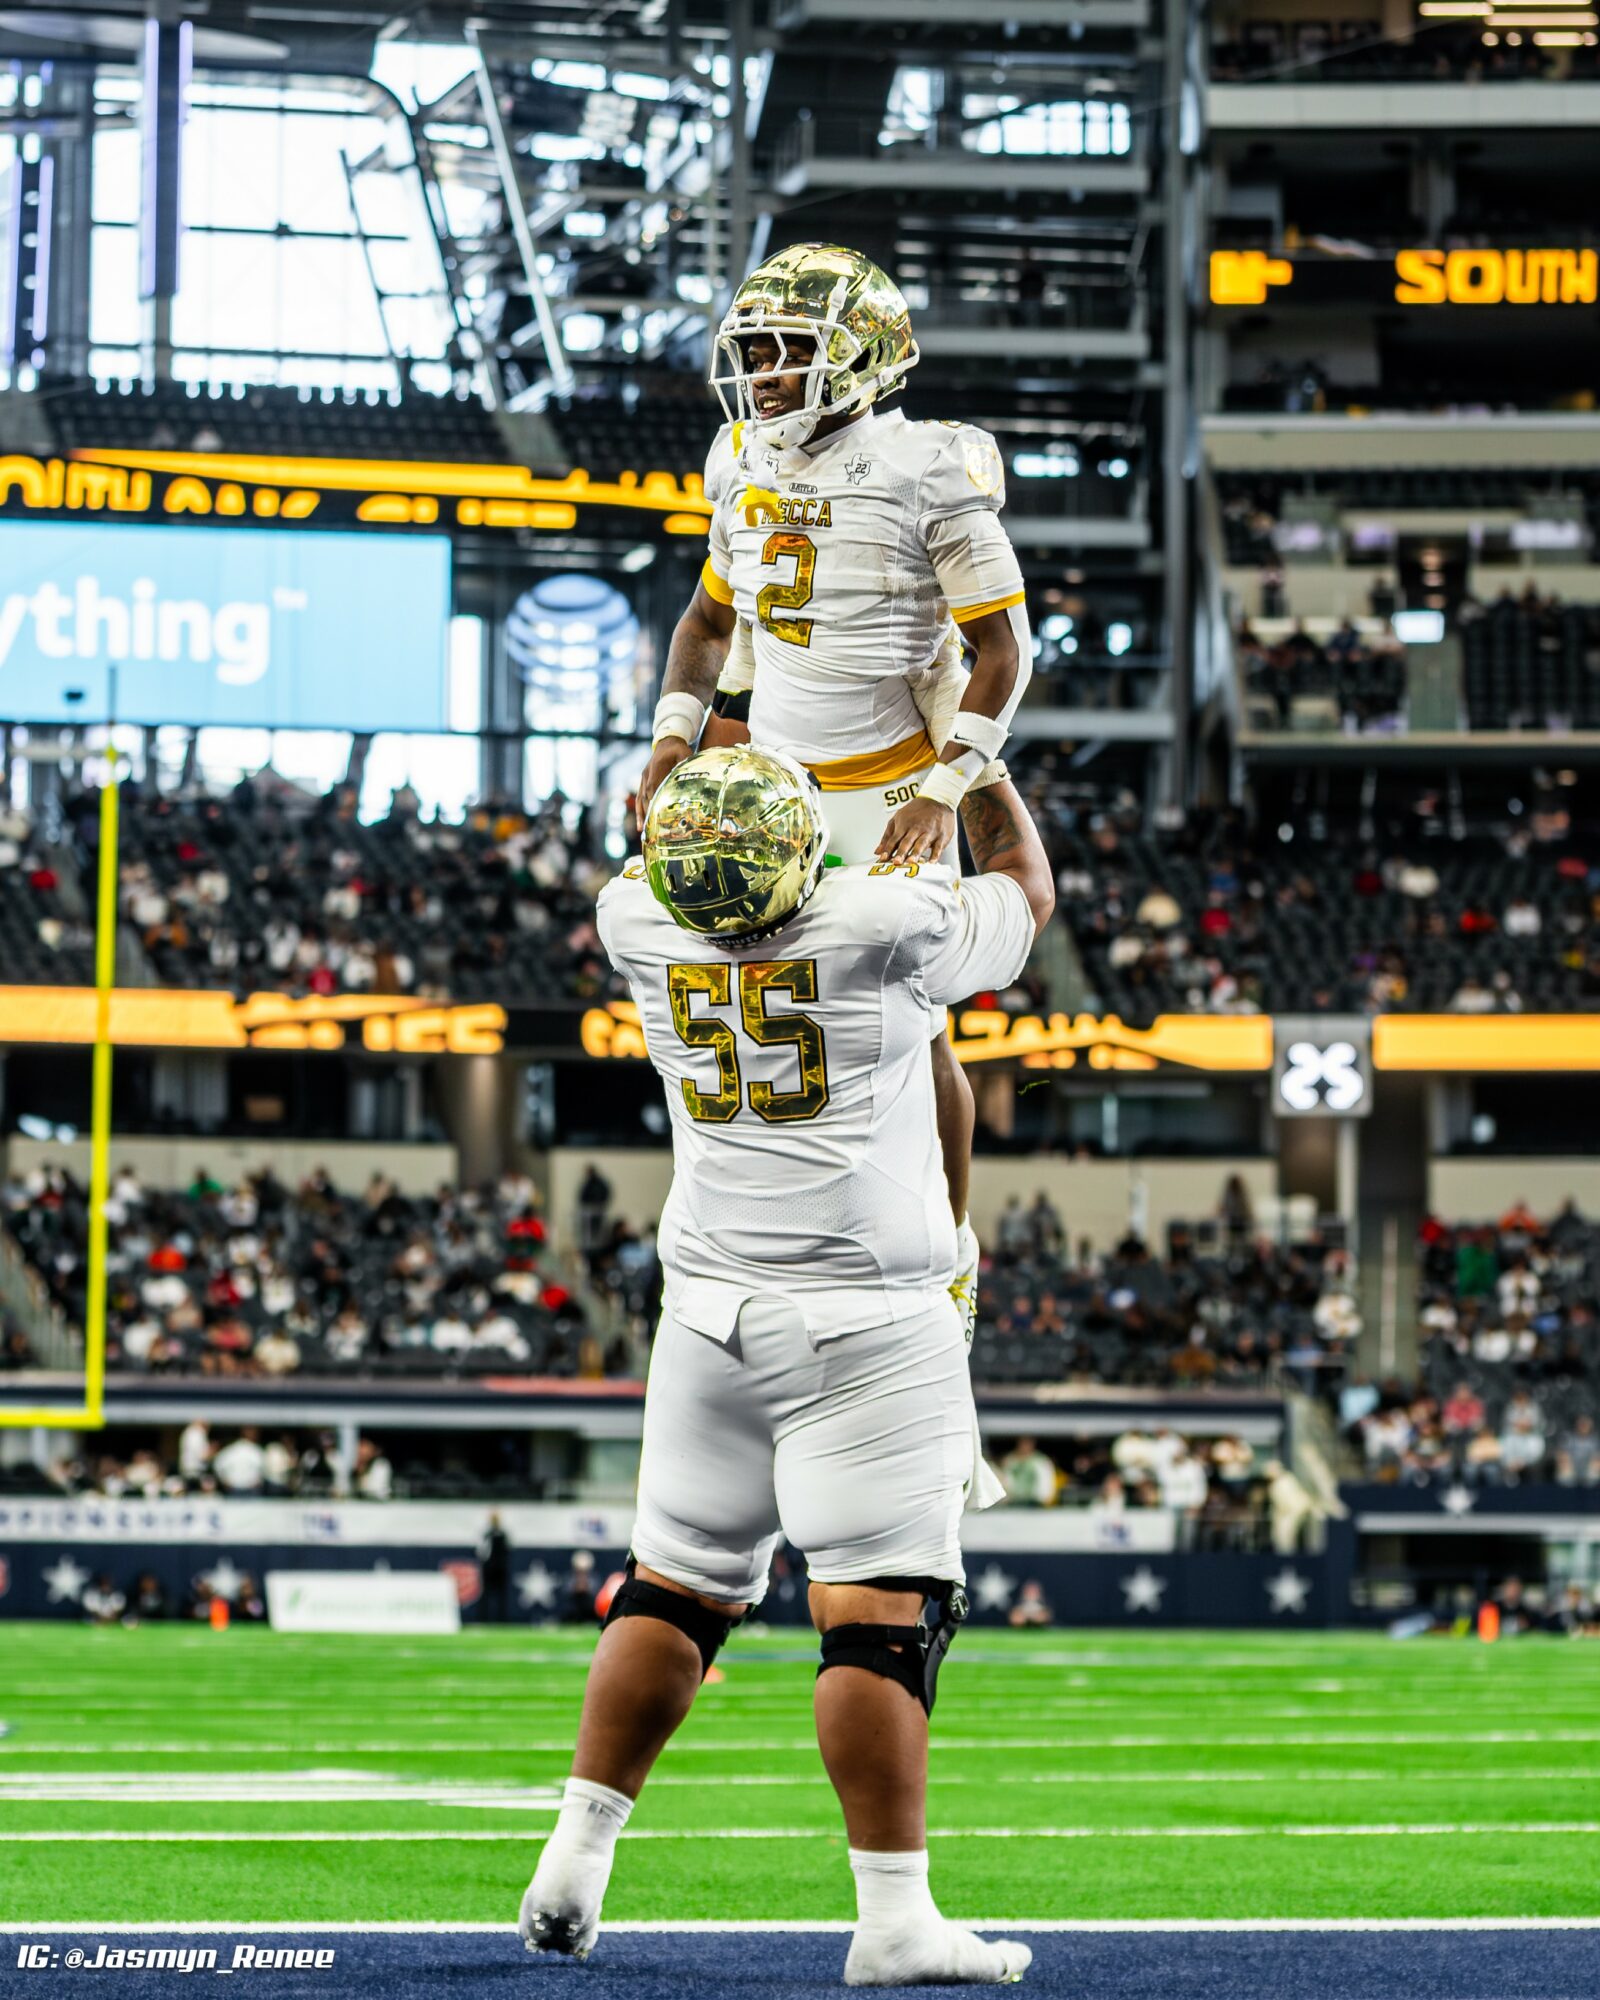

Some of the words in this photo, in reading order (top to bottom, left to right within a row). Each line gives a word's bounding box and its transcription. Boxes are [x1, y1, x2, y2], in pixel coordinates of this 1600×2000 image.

[1395, 249, 1598, 304] SOUTH
[855, 463, 867, 474] 22
[756, 531, 817, 649] 2
[667, 959, 830, 1123] 55
